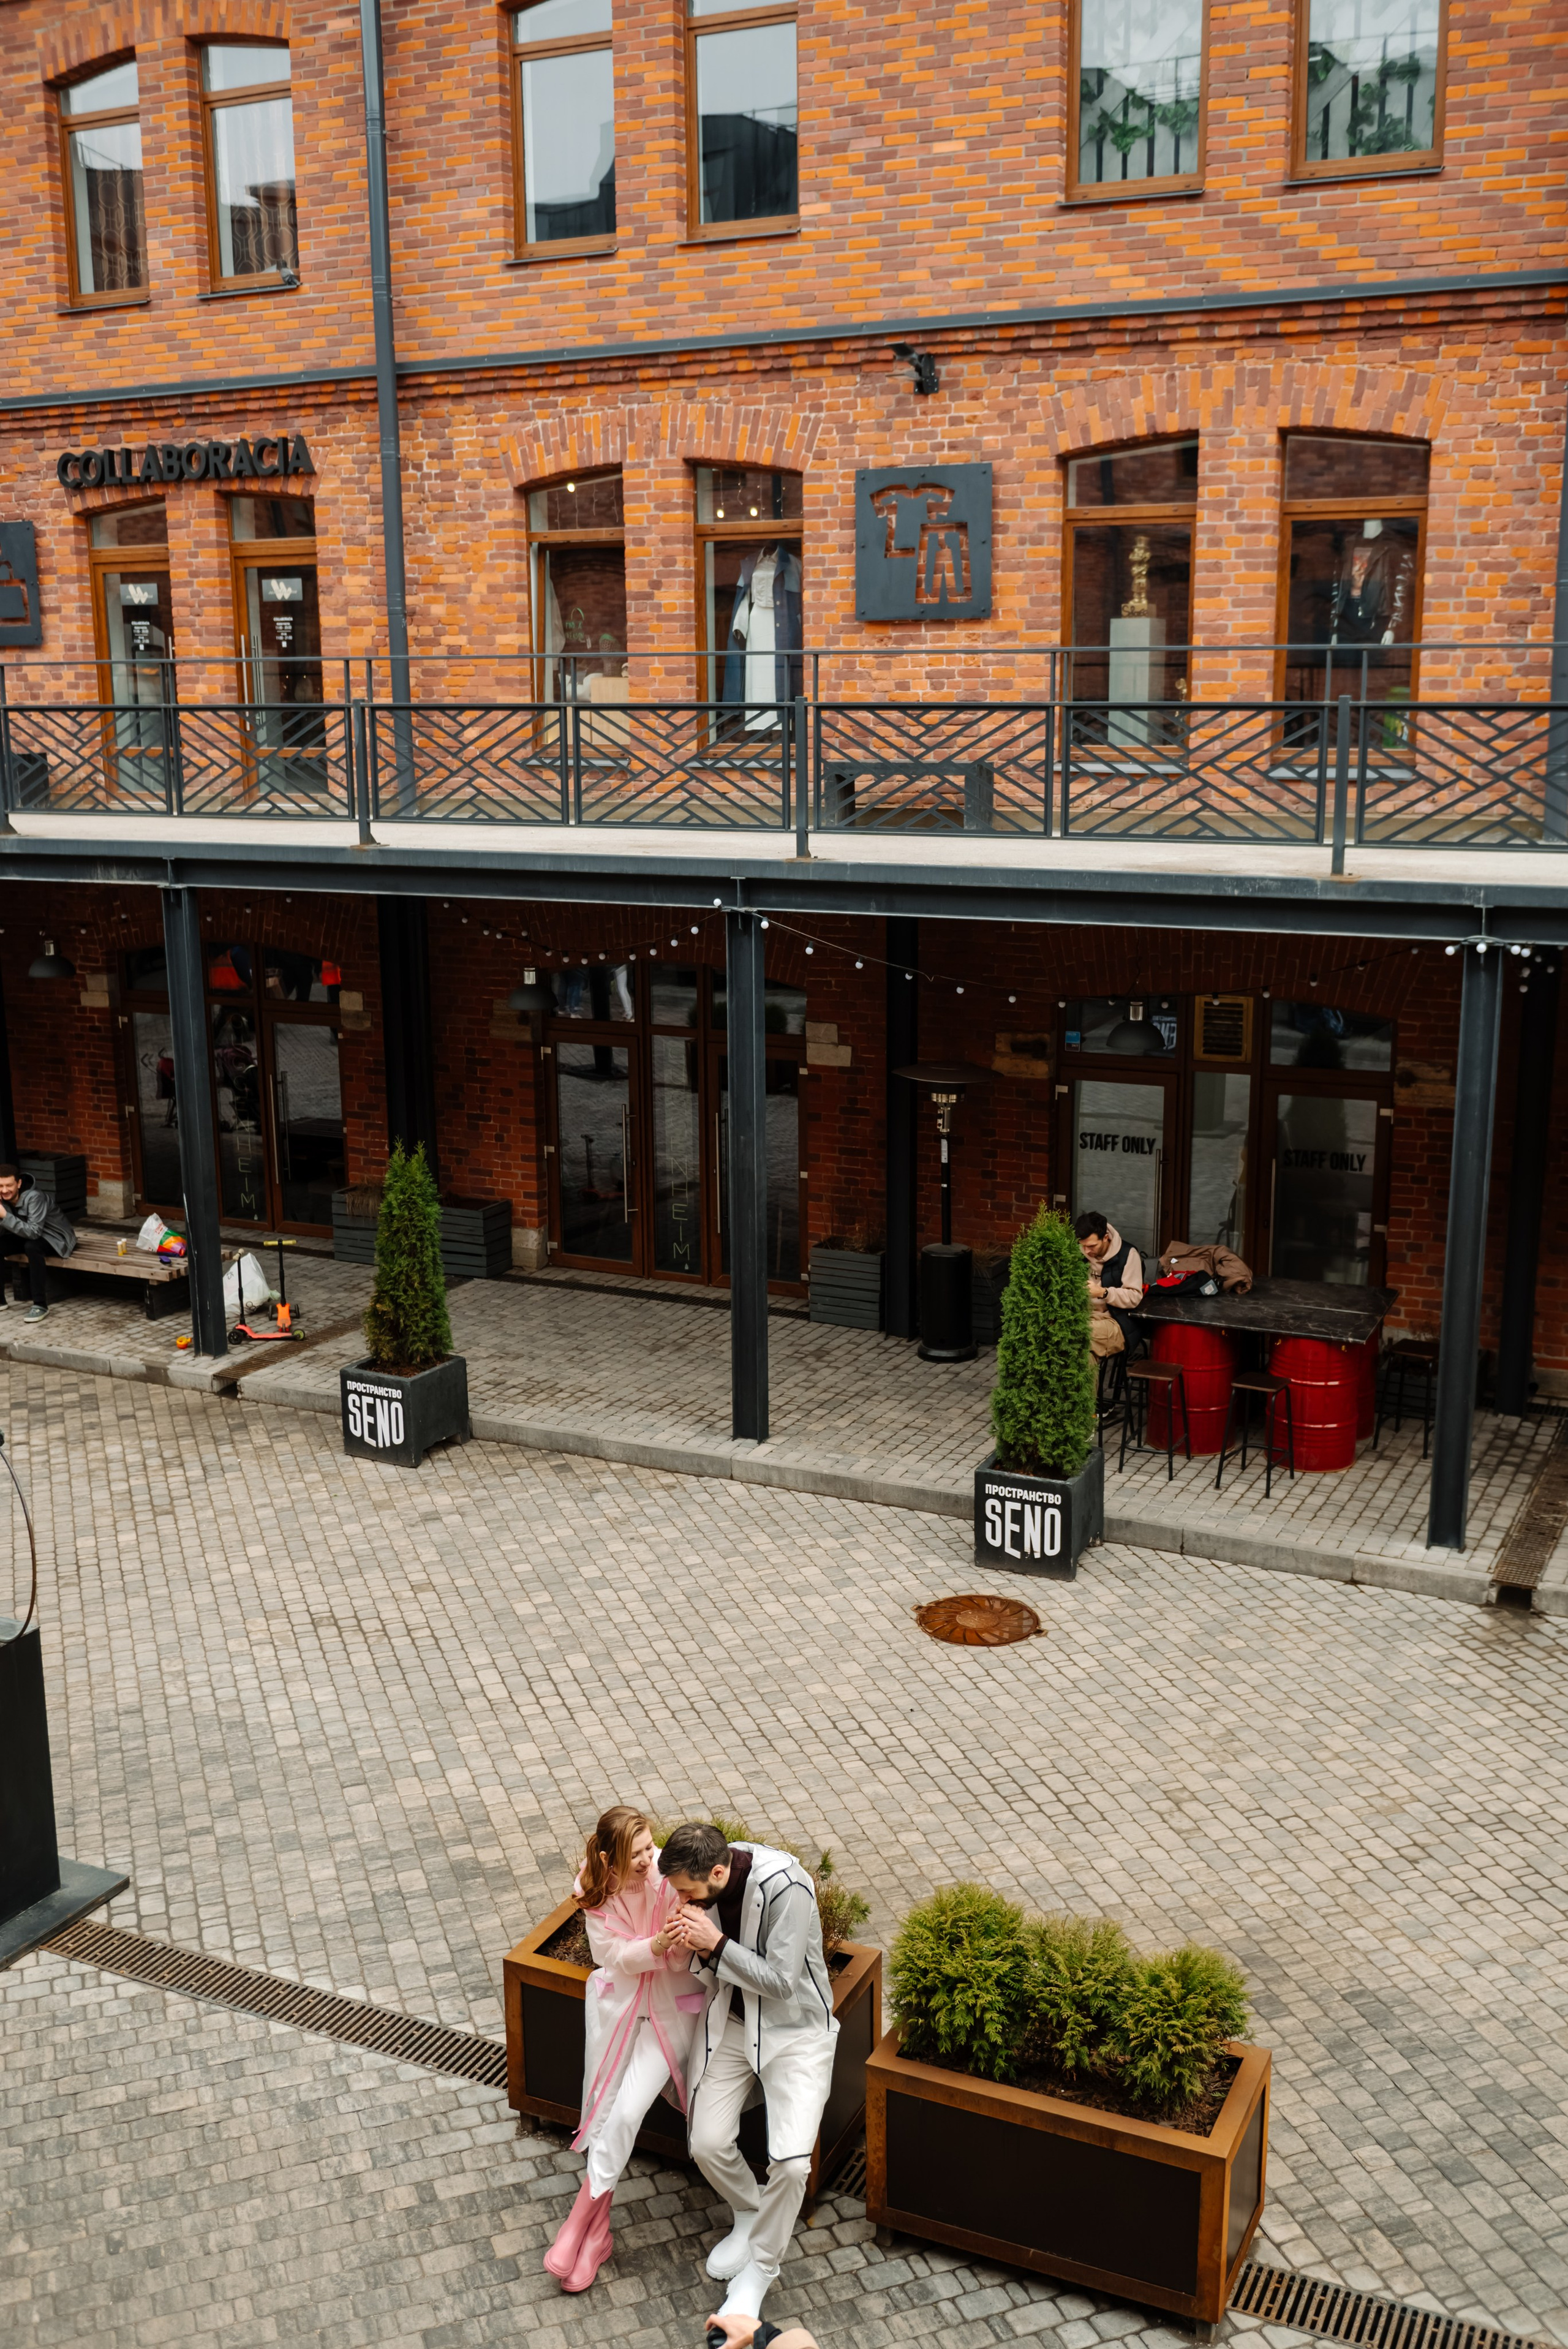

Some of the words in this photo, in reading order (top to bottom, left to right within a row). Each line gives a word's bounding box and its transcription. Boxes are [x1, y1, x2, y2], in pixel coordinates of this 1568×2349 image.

[57, 434, 317, 489] COLLABORACIA
[1079, 1132, 1120, 1152] STAFF
[1122, 1136, 1156, 1155] ONLY
[1284, 1149, 1327, 1169] STAFF
[1330, 1152, 1366, 1172] ONLY
[347, 1380, 402, 1400] ПРОСТРАНСТВО
[347, 1393, 404, 1449] SENO
[985, 1484, 1061, 1505] ПРОСТРАНСТВО
[985, 1498, 1061, 1559] SENO
